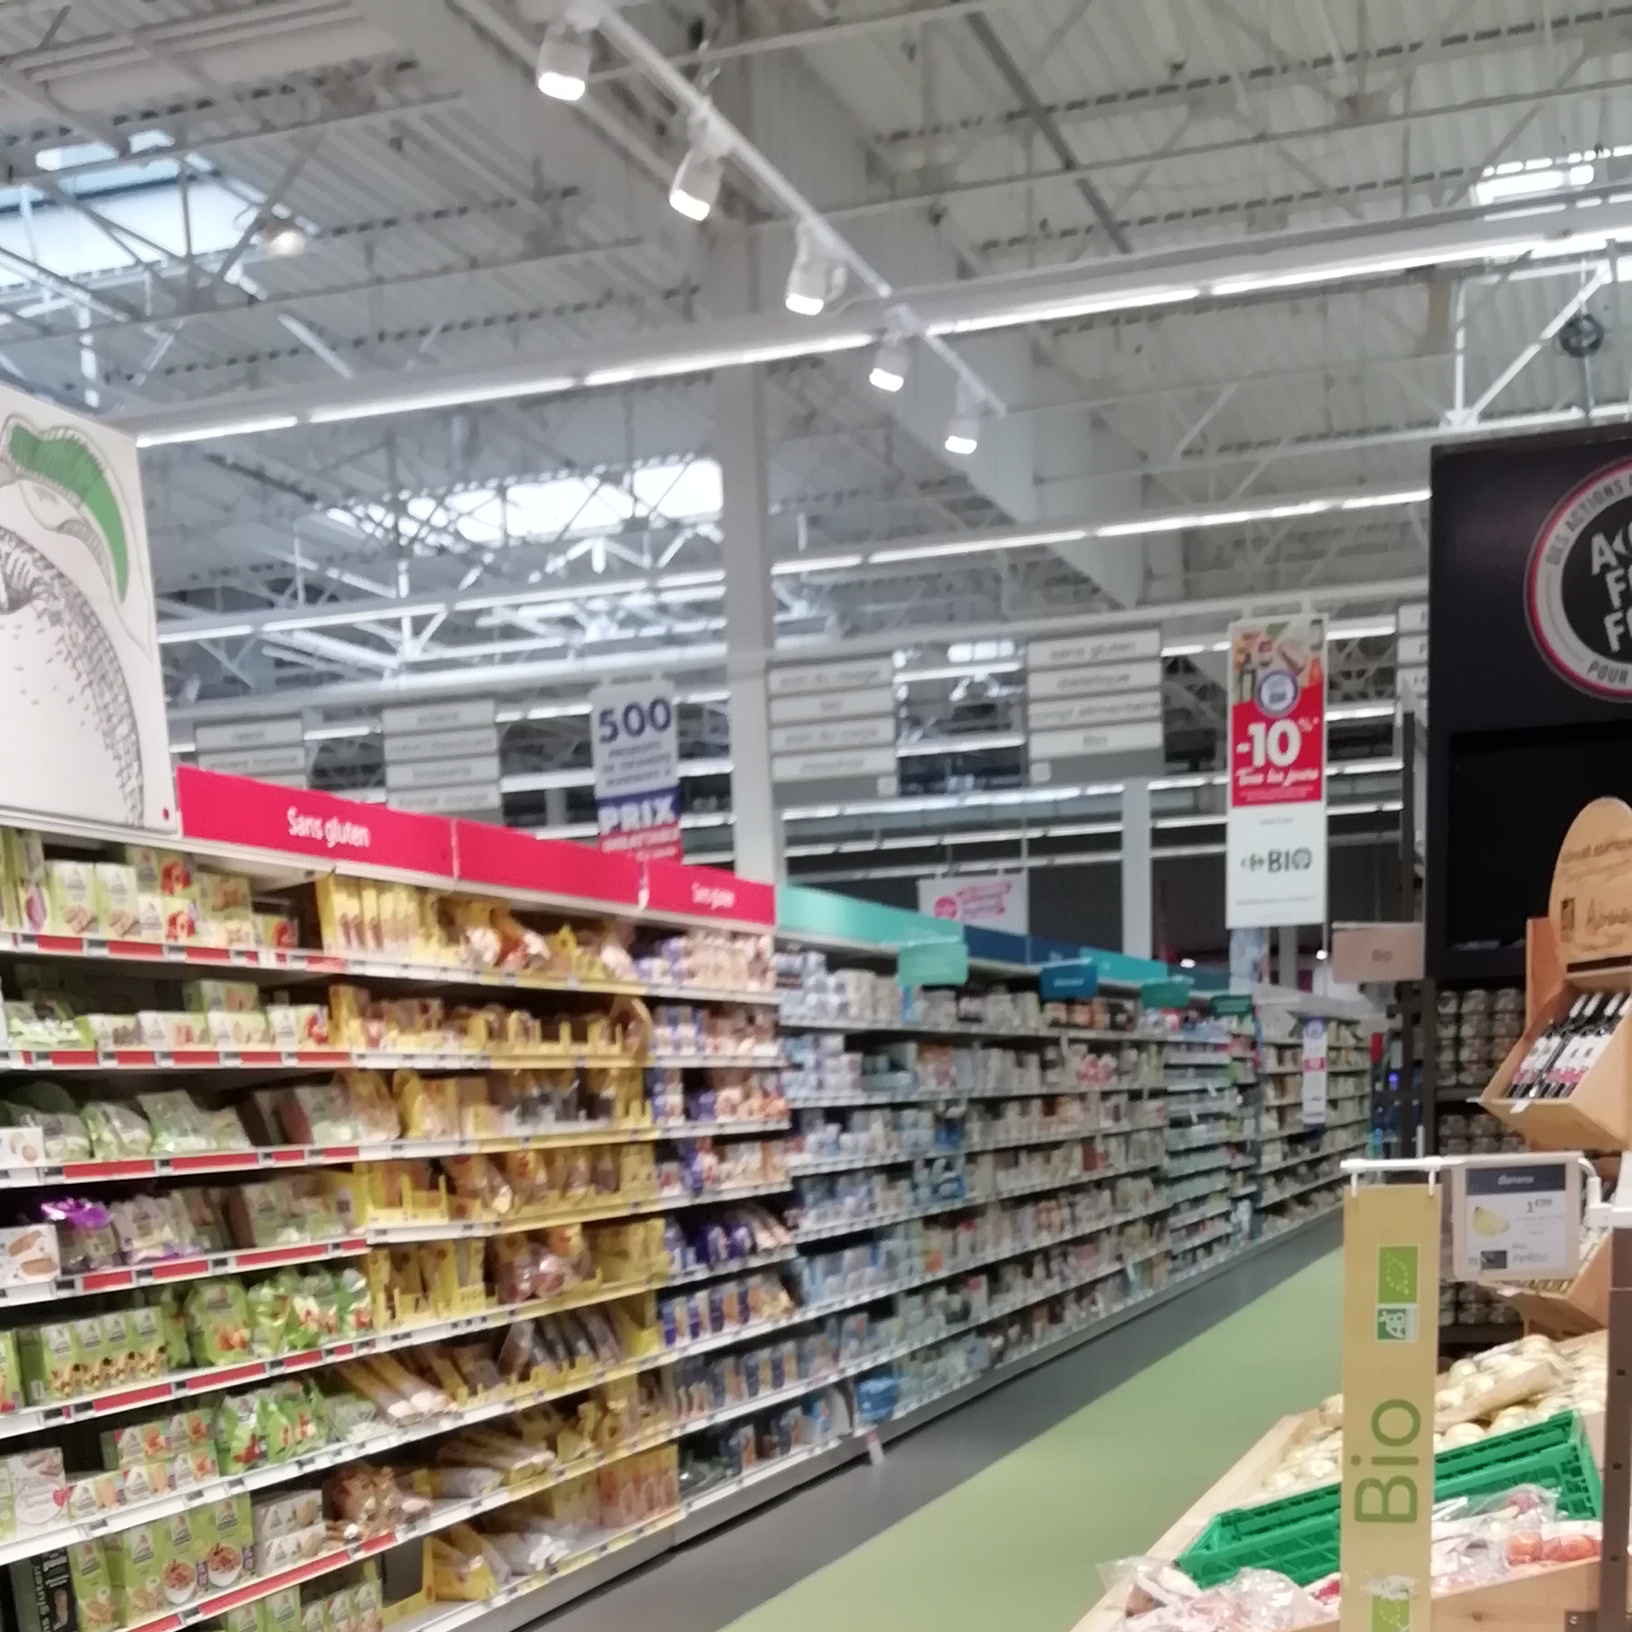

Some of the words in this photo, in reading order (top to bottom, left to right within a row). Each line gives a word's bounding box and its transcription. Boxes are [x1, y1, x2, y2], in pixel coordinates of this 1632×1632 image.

[1564, 479, 1625, 533] ACTIONS
[1587, 659, 1630, 685] POUR
[598, 697, 672, 744] 500
[286, 805, 323, 841] Sans
[325, 815, 372, 849] gluten
[597, 793, 675, 837] PRIX
[1351, 1397, 1422, 1524] Bio
